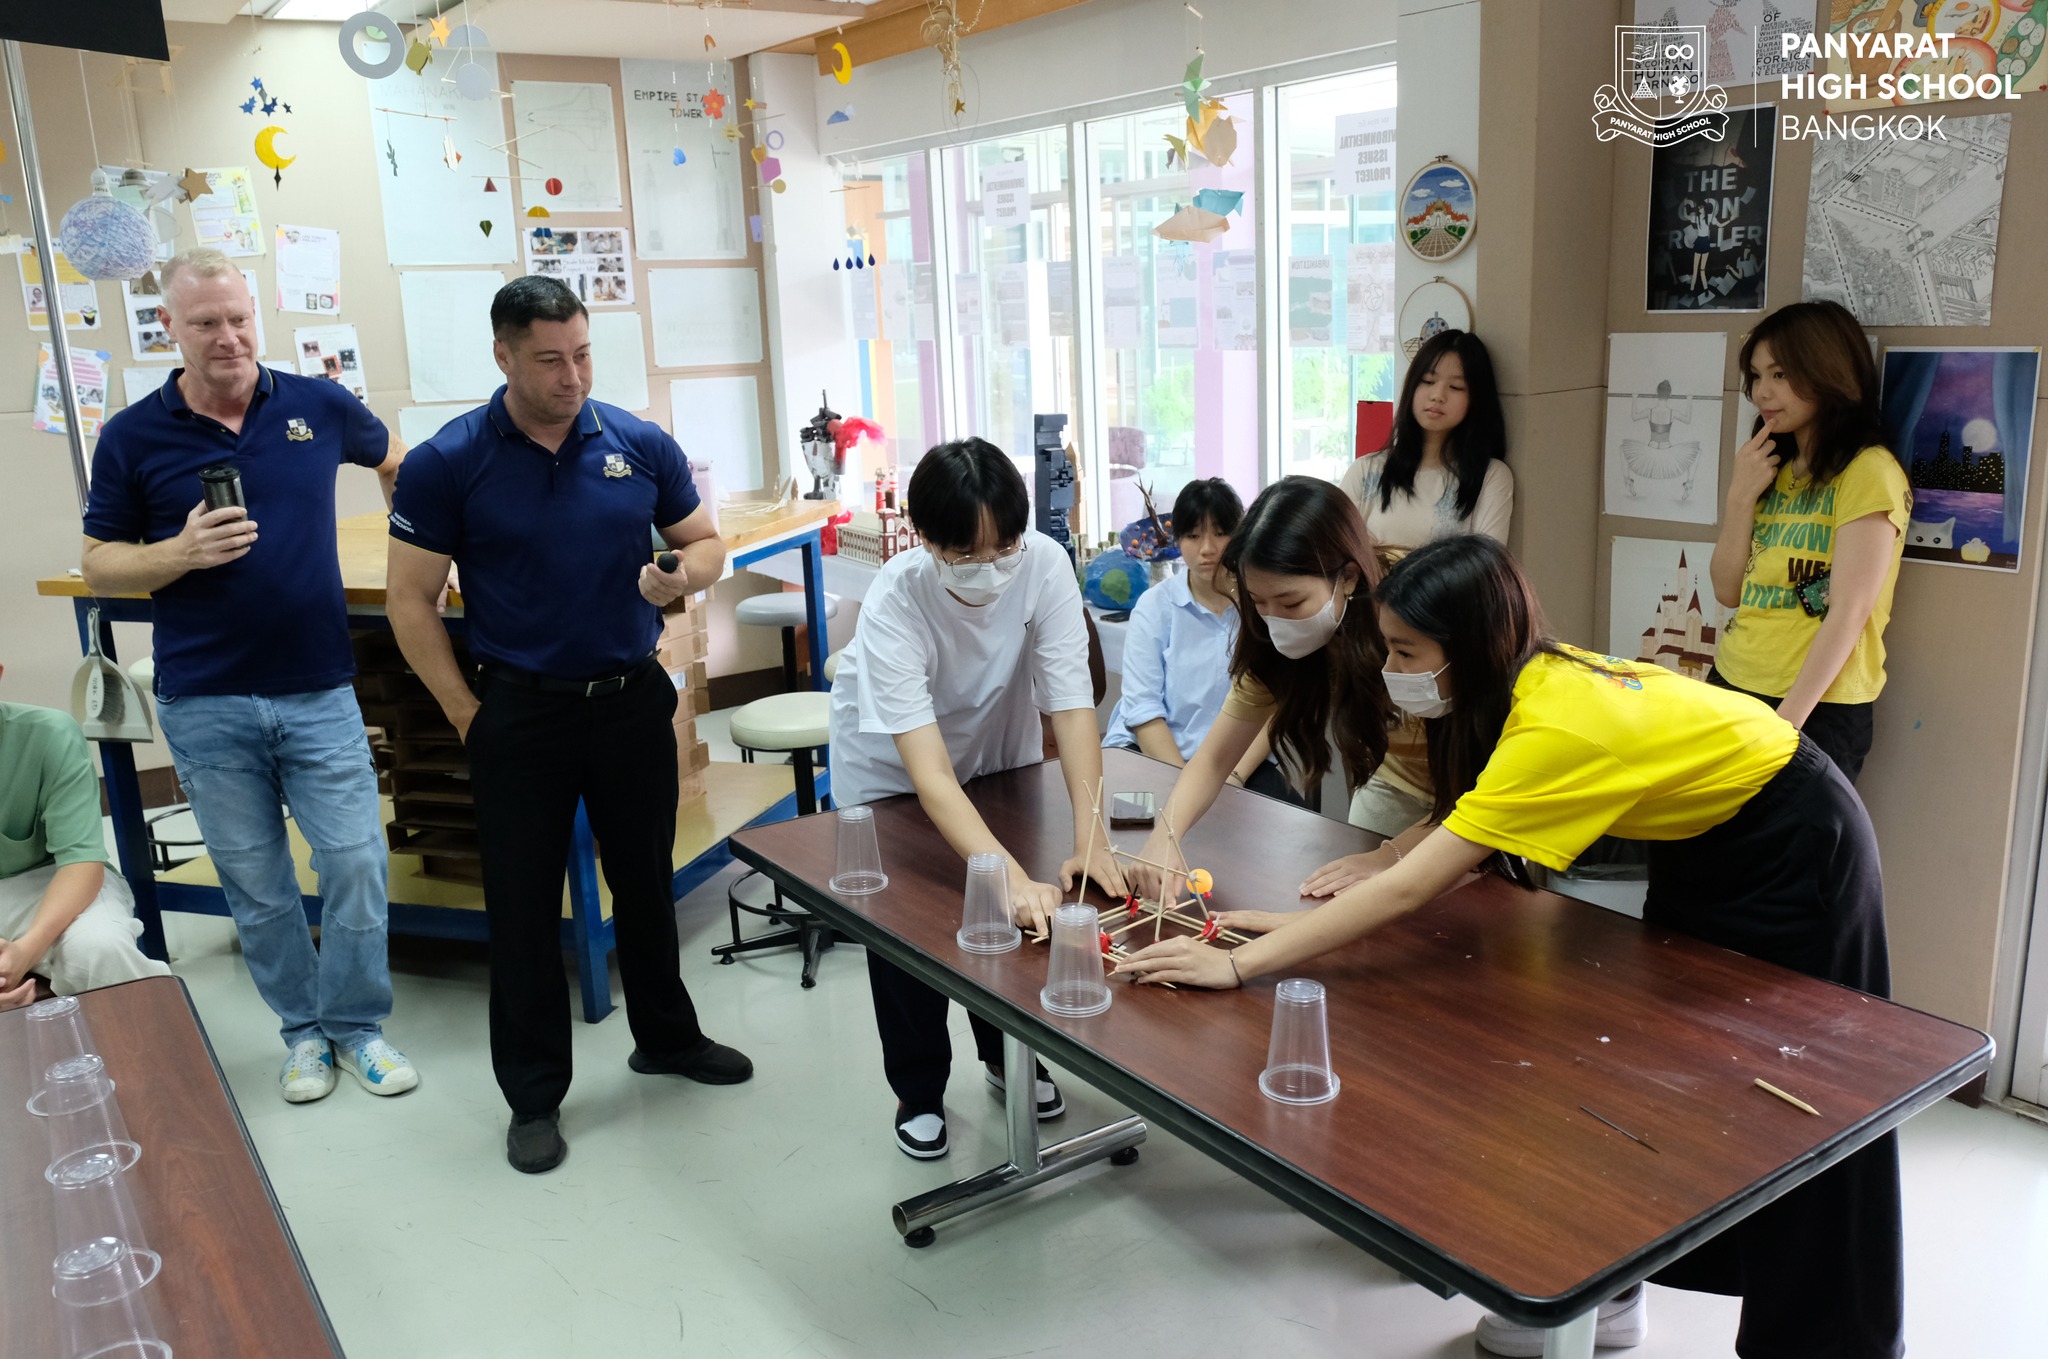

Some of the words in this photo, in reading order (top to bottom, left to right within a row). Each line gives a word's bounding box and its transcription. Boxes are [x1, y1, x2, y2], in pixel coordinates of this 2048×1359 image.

[1764, 12, 1781, 22] OF
[1634, 61, 1694, 80] HUMAN
[1765, 64, 1810, 75] ELECTION
[634, 89, 678, 102] EMPIRE
[669, 107, 703, 119] TOWER
[1684, 167, 1738, 193] THE
[1741, 580, 1799, 610] LIVED
